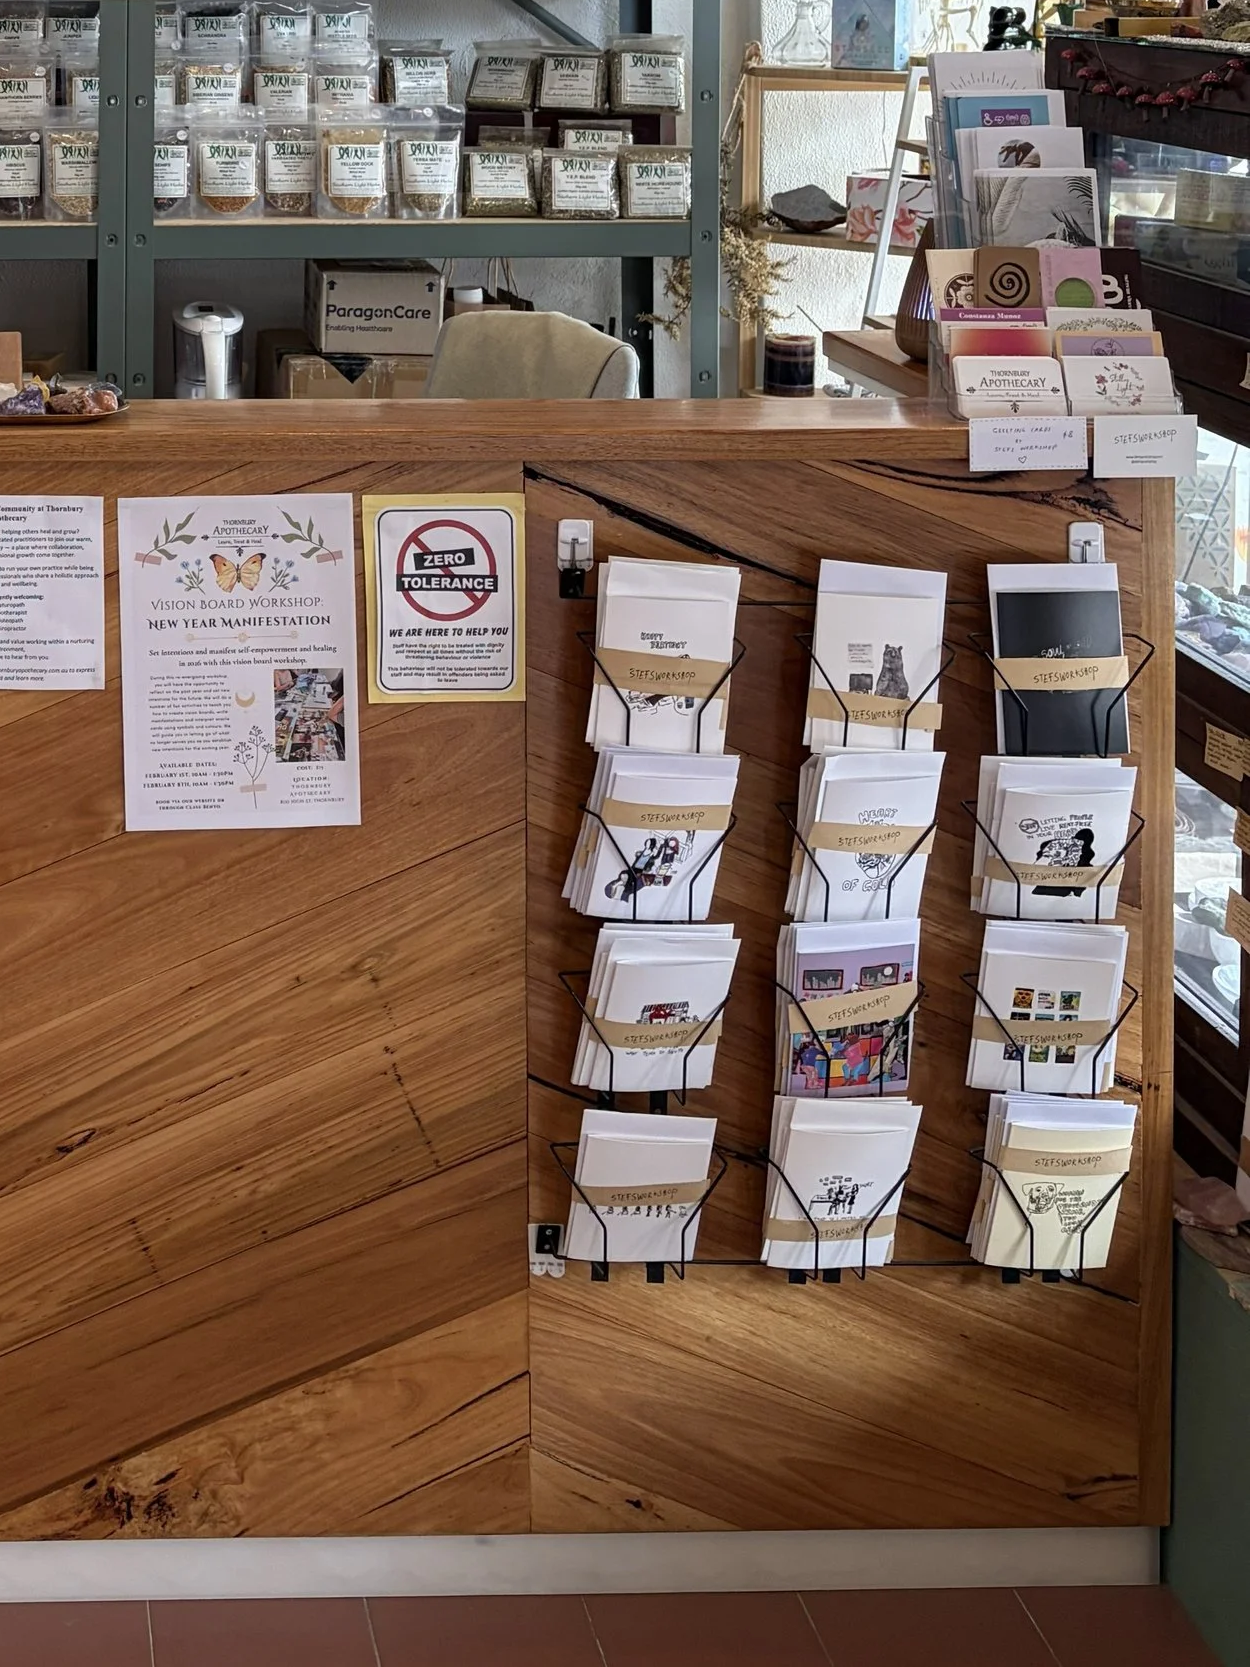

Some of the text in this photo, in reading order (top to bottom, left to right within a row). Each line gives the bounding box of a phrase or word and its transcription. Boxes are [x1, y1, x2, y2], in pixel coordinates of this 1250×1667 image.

[326, 304, 431, 321] ParagonCare
[959, 312, 994, 320] Constanza
[326, 324, 354, 332] Enabling
[980, 377, 1046, 388] APOTHECARY
[1114, 429, 1177, 445] STEFSWORKSHOP
[46, 505, 83, 513] Thornbury
[213, 525, 269, 535] APOTHECARY
[423, 552, 465, 567] ZERO
[402, 577, 494, 590] TOLERANCE
[151, 595, 324, 611] VISION BOARD WORKSHOP:
[147, 615, 331, 631] NEW YEAR MANIFESTATION
[389, 627, 509, 637] WE ARE HERE TO HELP YOU
[209, 647, 236, 655] manifest
[238, 645, 297, 655] self-empowerment
[313, 645, 337, 653] healing
[274, 656, 307, 665] workshop.
[630, 668, 696, 683] STEFSWORKSHOP
[1033, 665, 1098, 683] STEFSWORKSHOP
[640, 811, 705, 824] STEFSWORKSHOP
[858, 808, 898, 824] HEART
[838, 831, 901, 846] STEFSWORKSHOP
[842, 879, 859, 891] OF
[828, 994, 890, 1023] STEFSWORKSHOP
[624, 1030, 688, 1044] STEFSWORKSHOP
[1035, 1156, 1102, 1168] STEFSWORKSHOP
[611, 1188, 678, 1202] STEFSWORKSHOP
